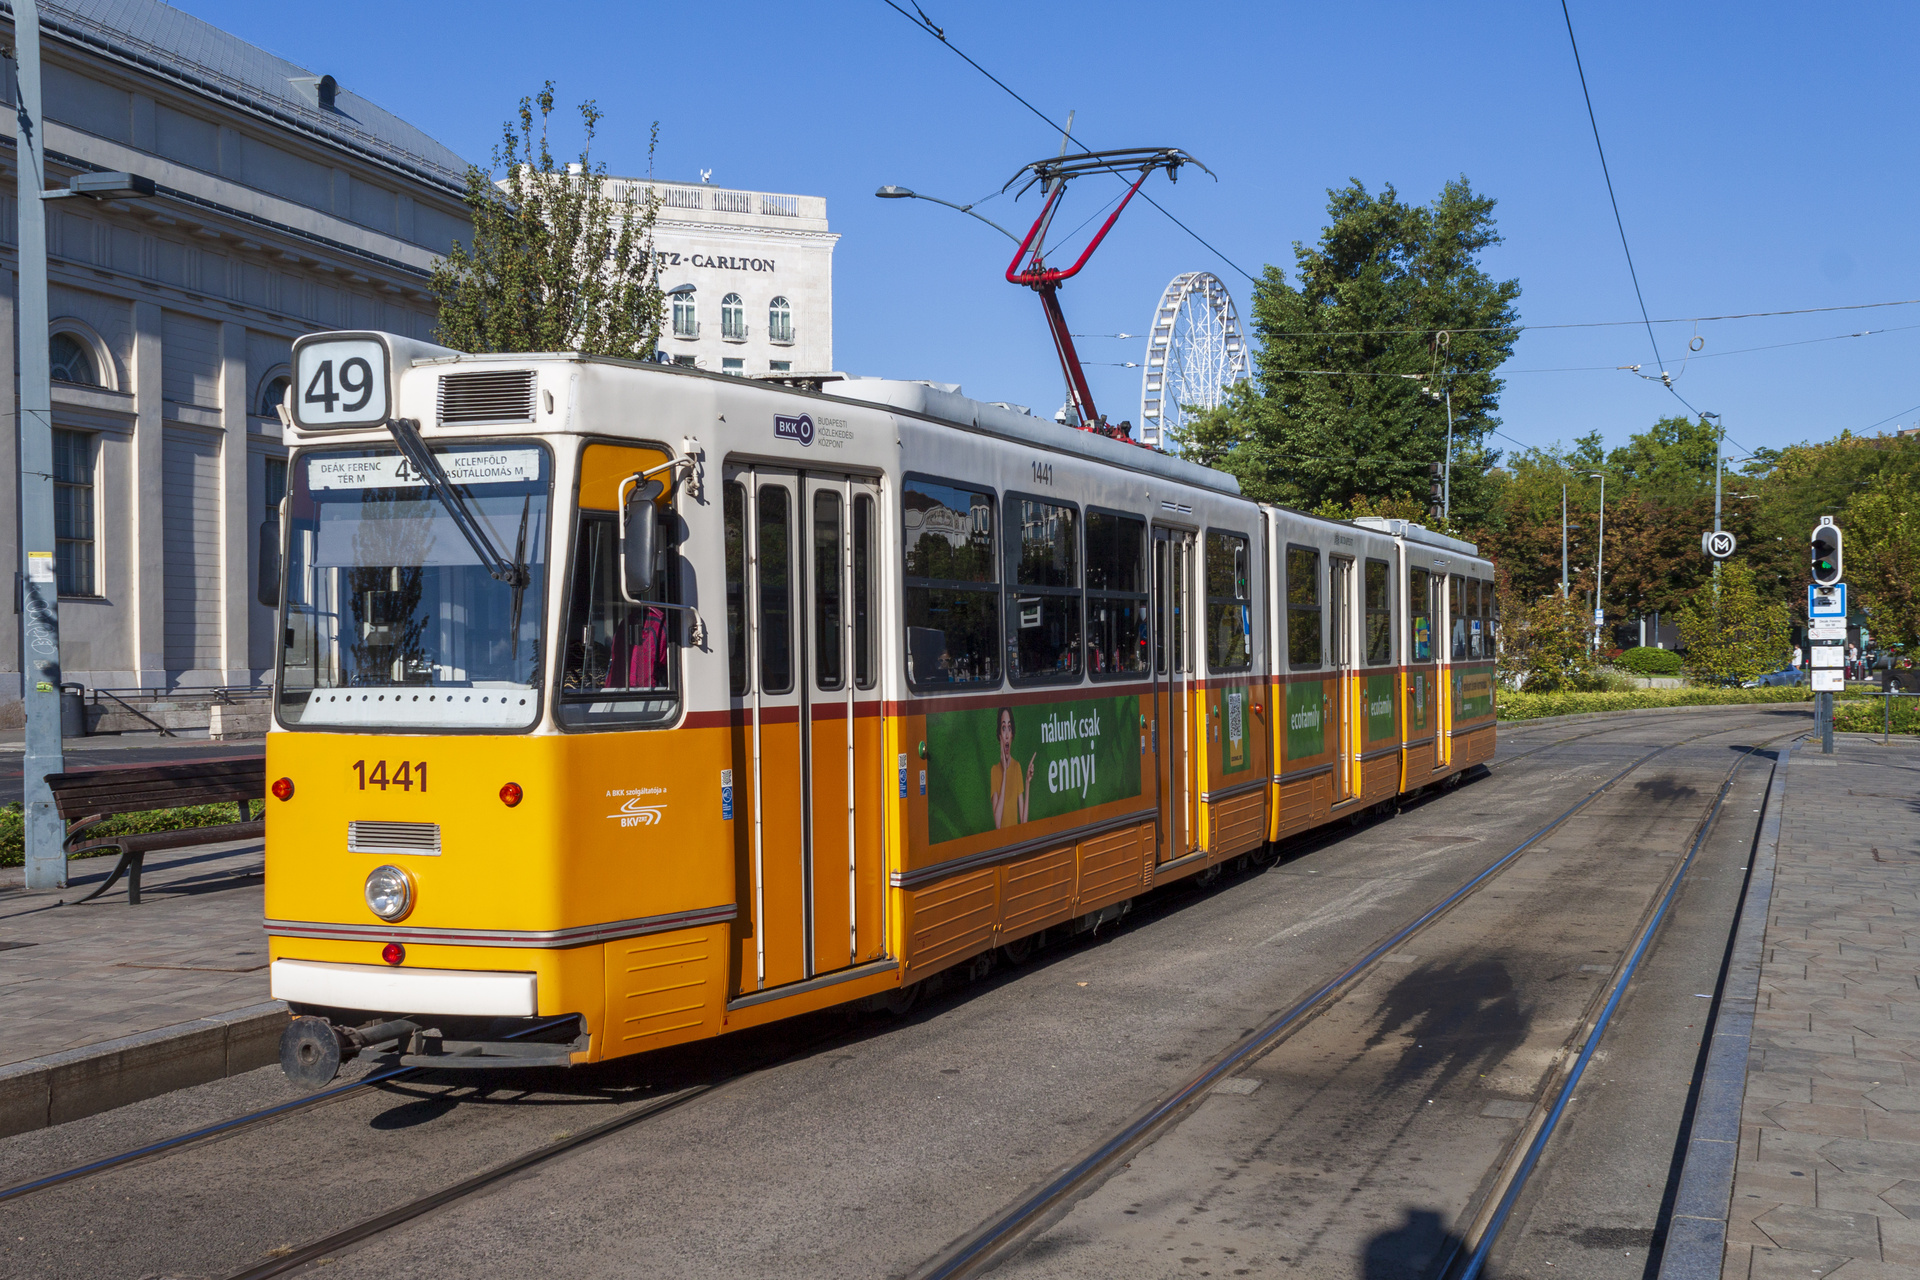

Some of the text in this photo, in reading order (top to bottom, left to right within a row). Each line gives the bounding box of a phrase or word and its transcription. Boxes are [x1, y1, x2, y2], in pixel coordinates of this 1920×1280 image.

[639, 250, 775, 272] RTZ-CARLTON
[305, 357, 373, 413] 49
[779, 421, 797, 434] BKK
[817, 417, 847, 428] BUDAPESTI
[817, 427, 854, 440] KÖZLEKEDÉSI
[817, 438, 844, 448] KÖZPONT
[321, 461, 382, 473] DEÁK FERENC
[514, 466, 524, 476] M
[1032, 460, 1053, 486] 1441
[337, 472, 366, 484] TÉR M
[1823, 517, 1831, 526] D
[1370, 694, 1392, 718] ecofamily
[1290, 703, 1320, 732] ecofamily
[1041, 708, 1100, 743] nálunk csak
[1048, 739, 1096, 799] ennyi
[352, 759, 427, 793] 1441
[626, 787, 662, 796] szolgáltatója
